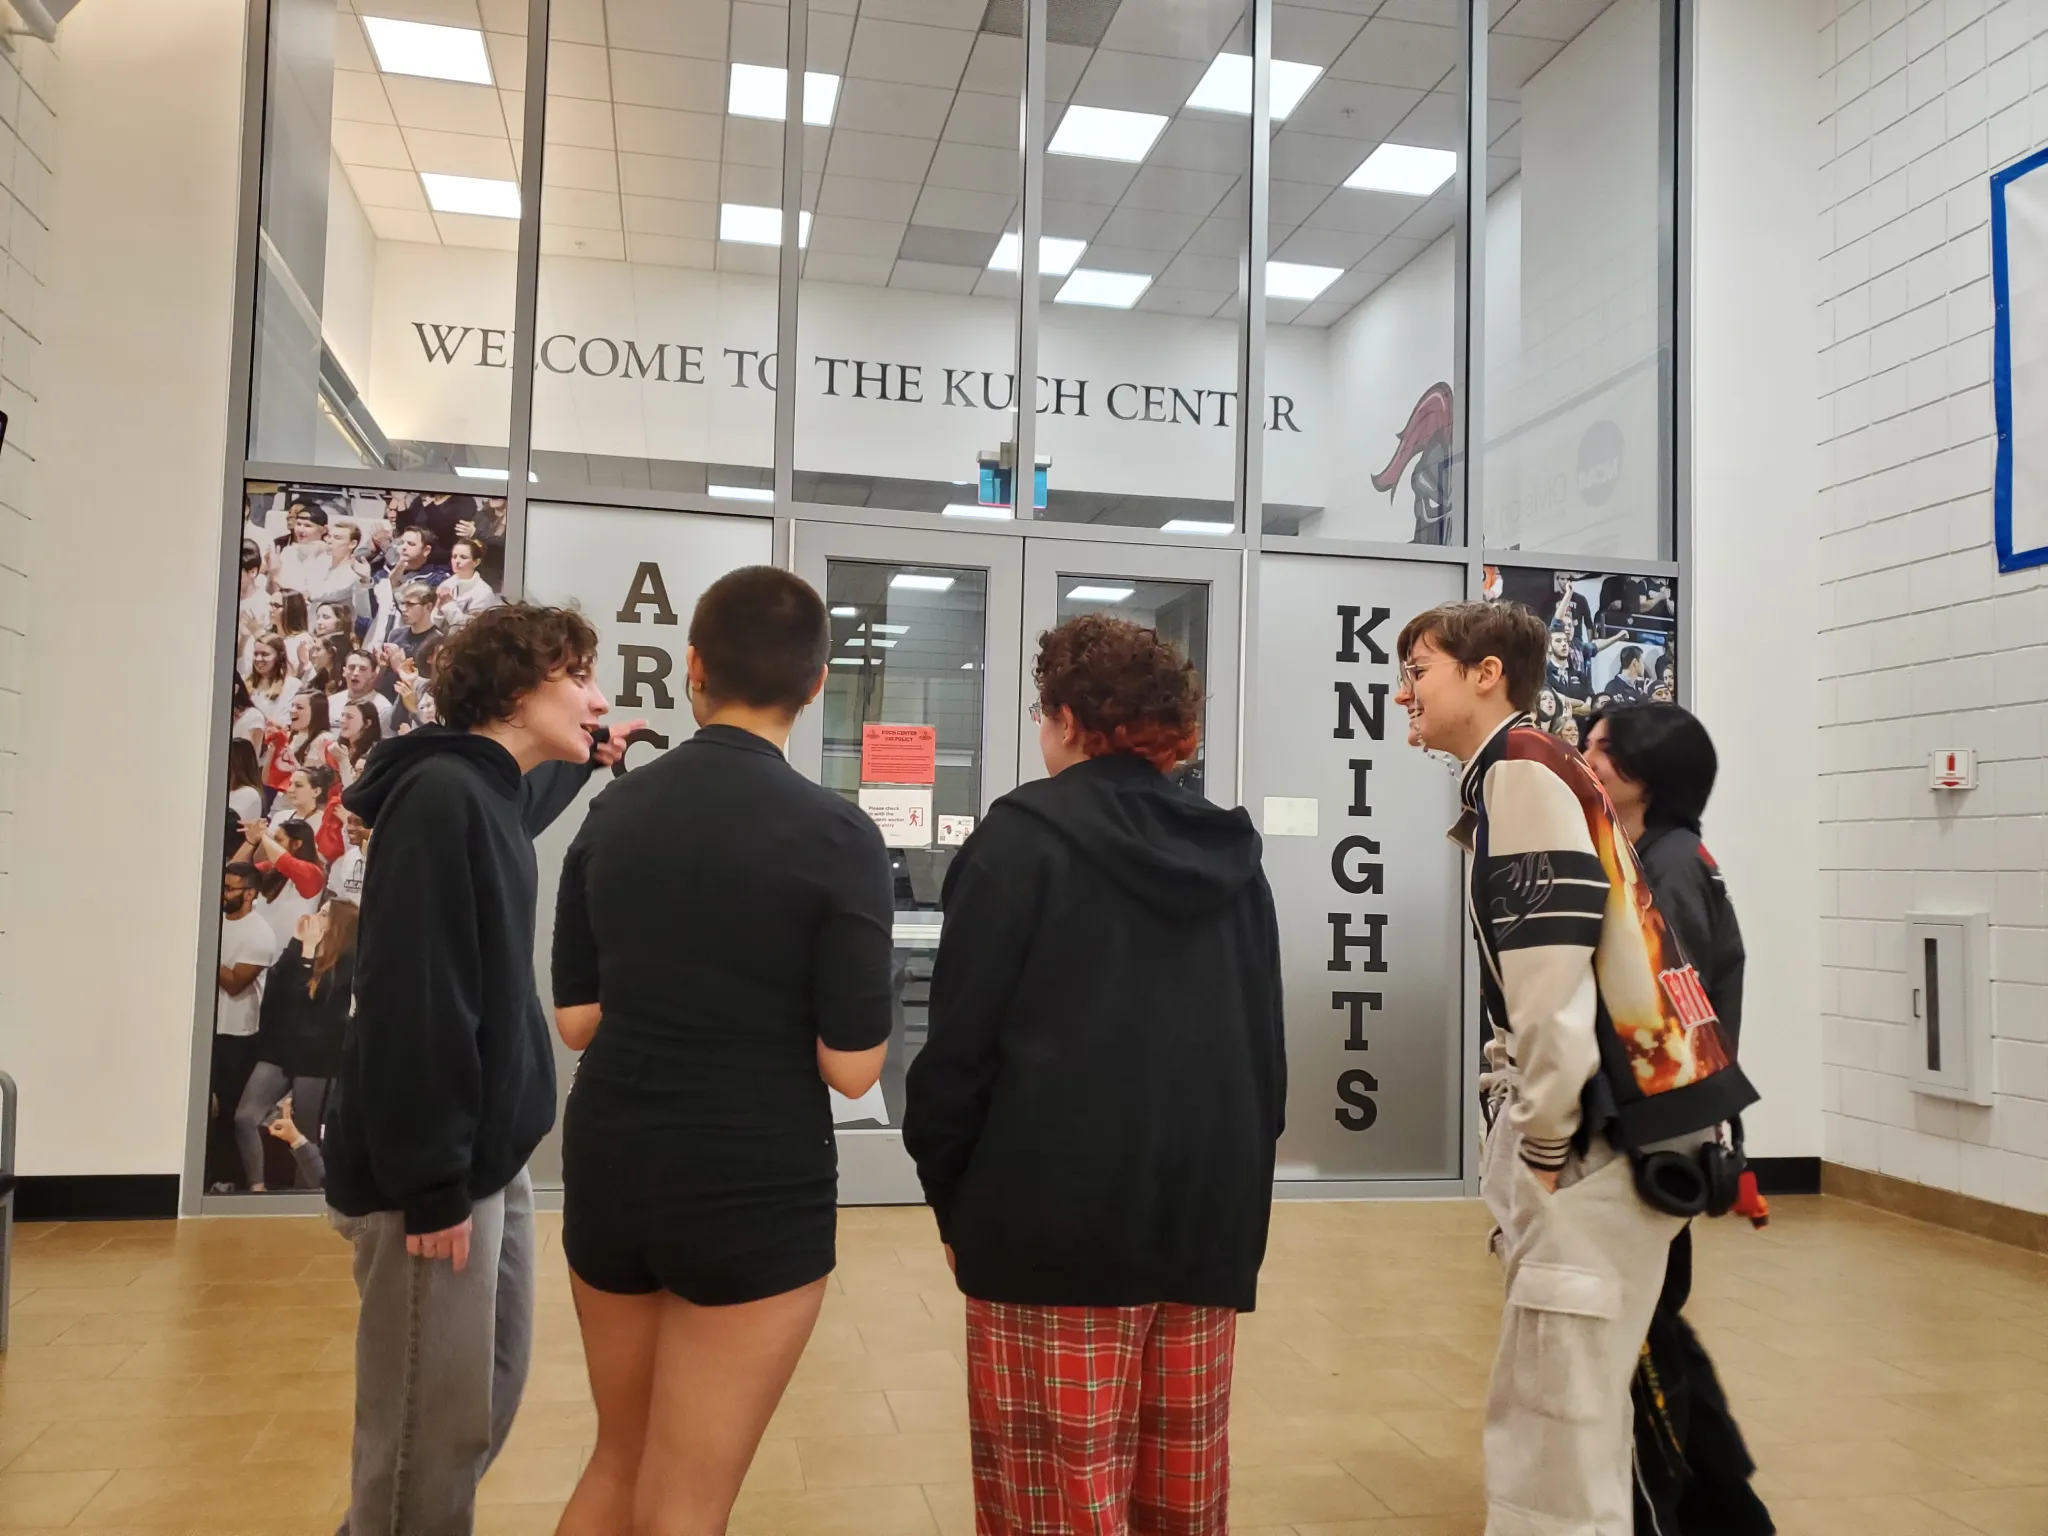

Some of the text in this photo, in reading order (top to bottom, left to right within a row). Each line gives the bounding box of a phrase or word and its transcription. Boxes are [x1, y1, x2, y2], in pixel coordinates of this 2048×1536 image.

[411, 322, 705, 385] WECOME
[814, 356, 923, 403] THE
[1107, 383, 1303, 433] CENTR
[1327, 604, 1391, 1132] KNIGHTS
